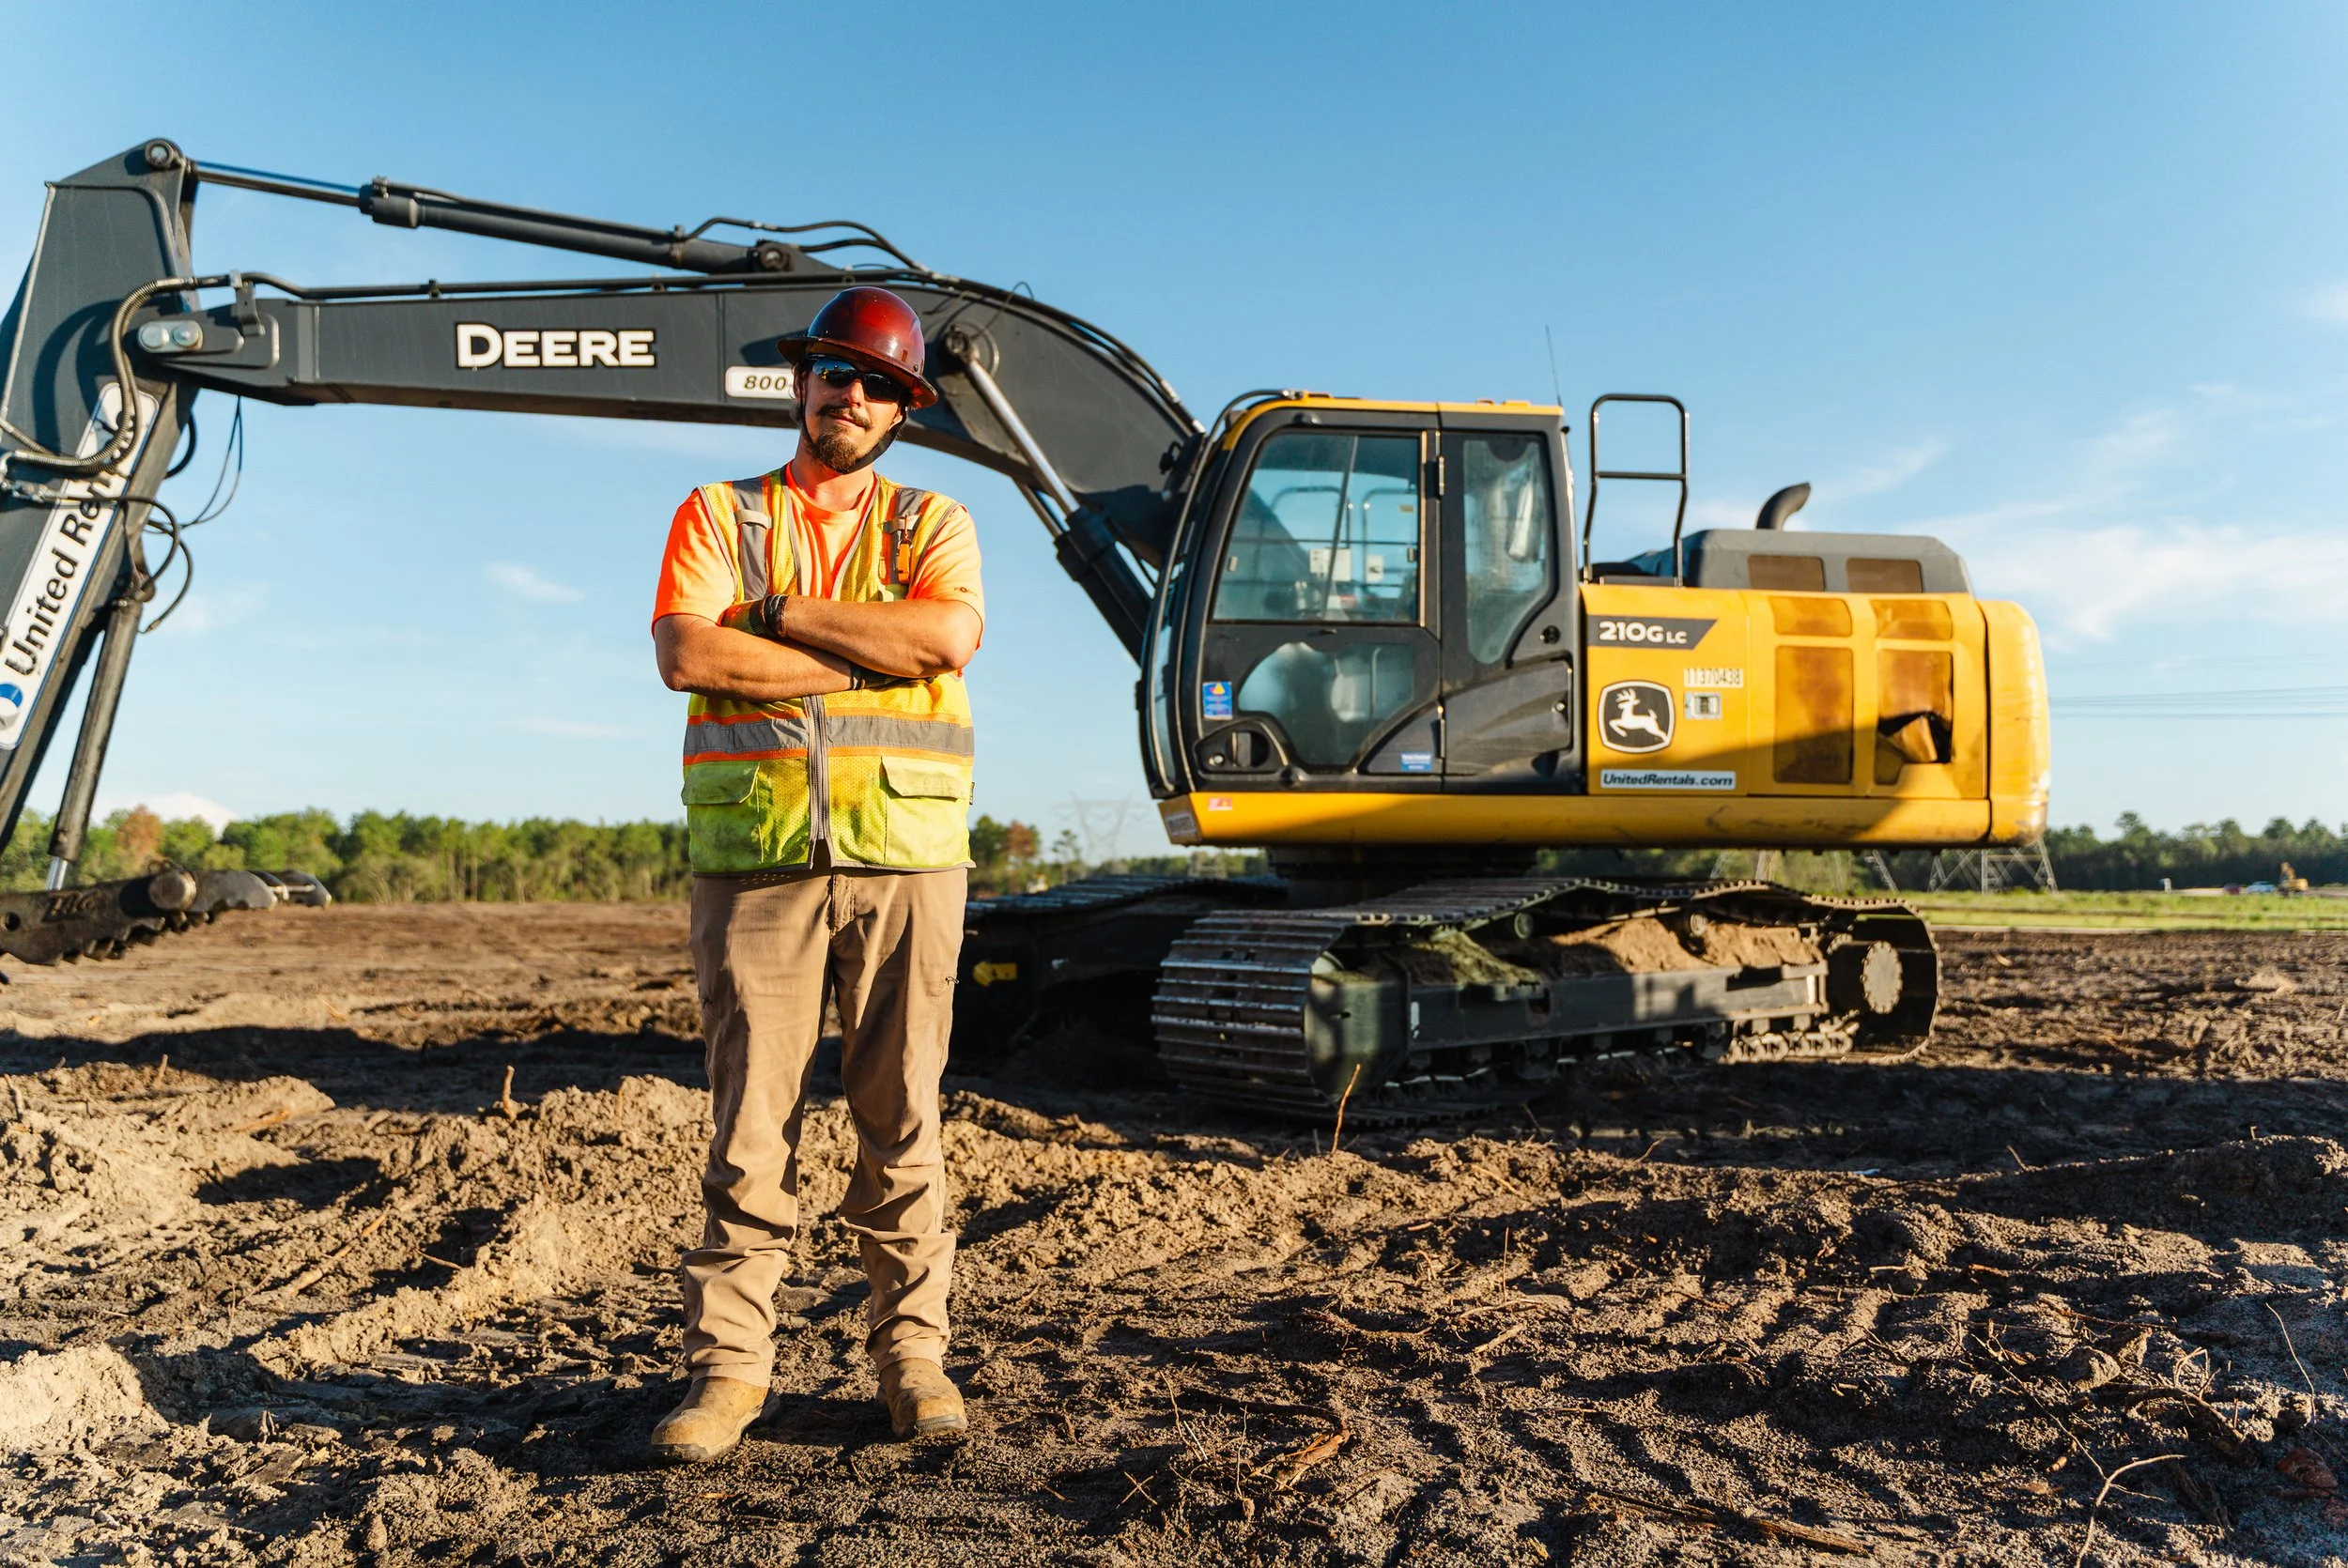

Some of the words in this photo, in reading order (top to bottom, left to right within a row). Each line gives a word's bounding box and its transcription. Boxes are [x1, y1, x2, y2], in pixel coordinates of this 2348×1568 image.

[456, 323, 656, 368] DEERE
[5, 548, 78, 675] United
[1687, 668, 1741, 685] 11370438
[1603, 773, 1733, 786] UnitedRentals.com
